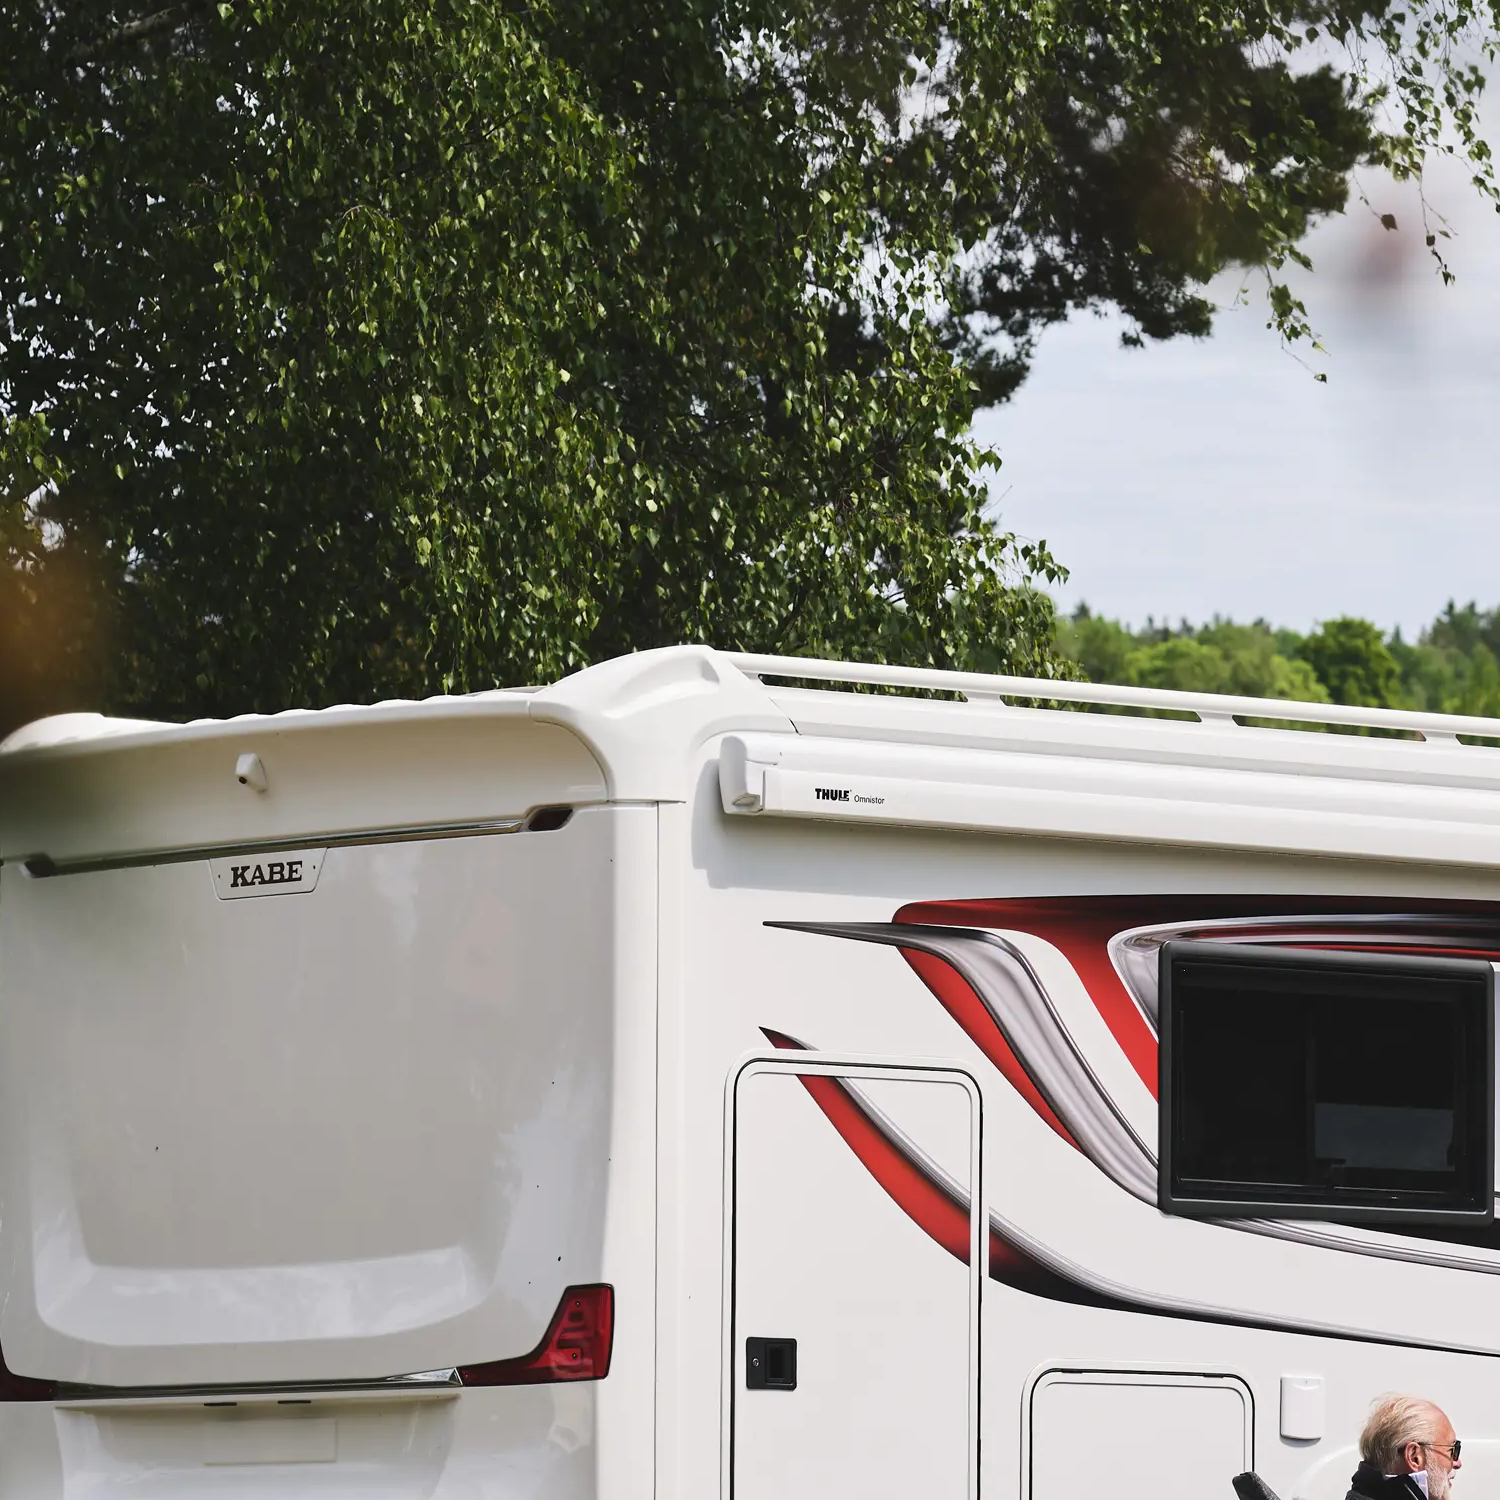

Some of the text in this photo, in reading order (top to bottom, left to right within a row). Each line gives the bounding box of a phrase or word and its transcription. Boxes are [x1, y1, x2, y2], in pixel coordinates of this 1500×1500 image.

[815, 788, 885, 804] THULE Omnistor
[230, 861, 303, 888] KABE
